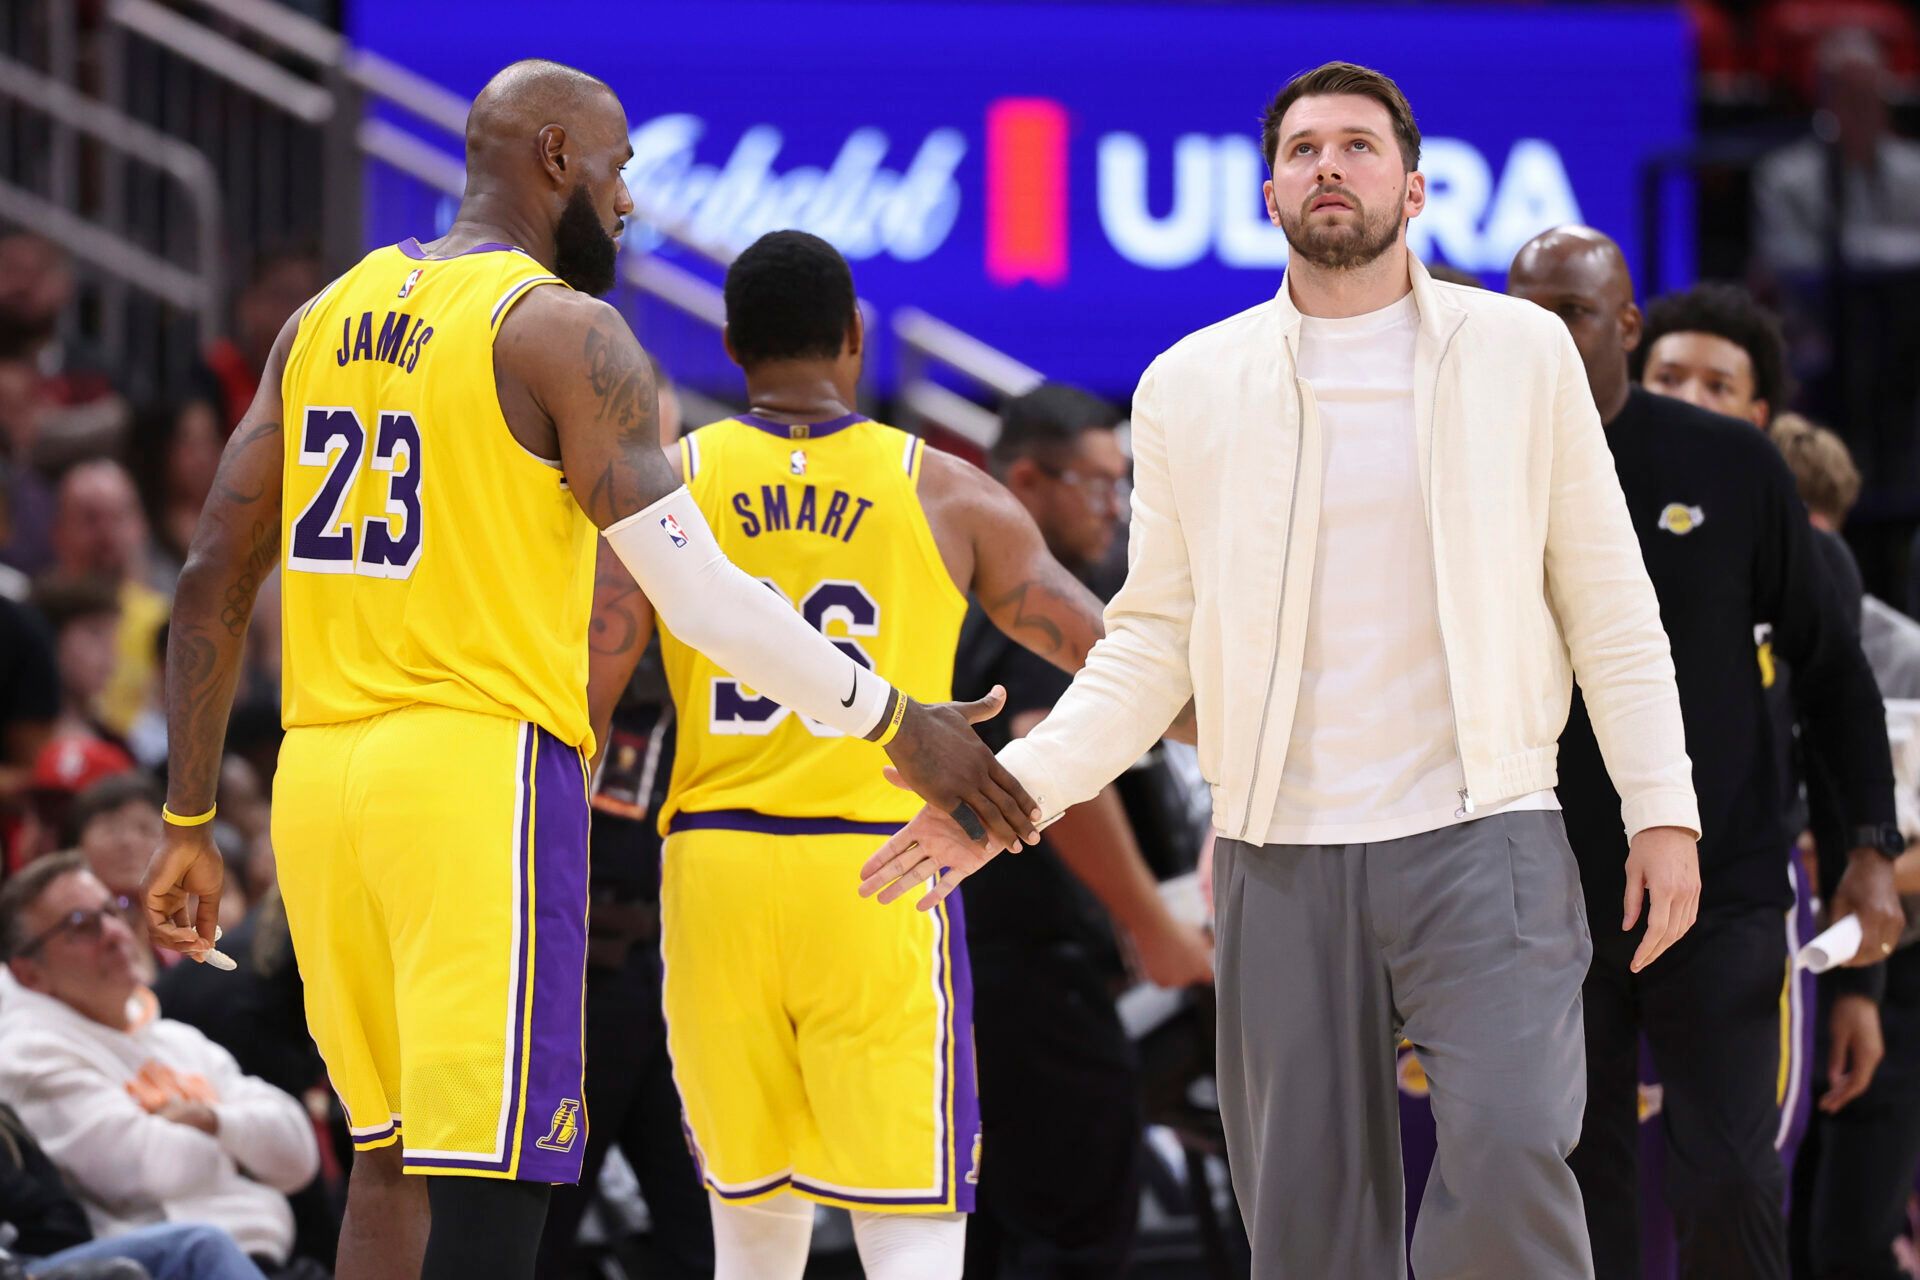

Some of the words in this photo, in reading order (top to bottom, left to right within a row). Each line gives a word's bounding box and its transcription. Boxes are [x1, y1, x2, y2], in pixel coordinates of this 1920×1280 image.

[1096, 131, 1588, 272] ULRA
[336, 311, 434, 374] JAMES
[288, 405, 424, 581] 23
[732, 484, 874, 543] SMART
